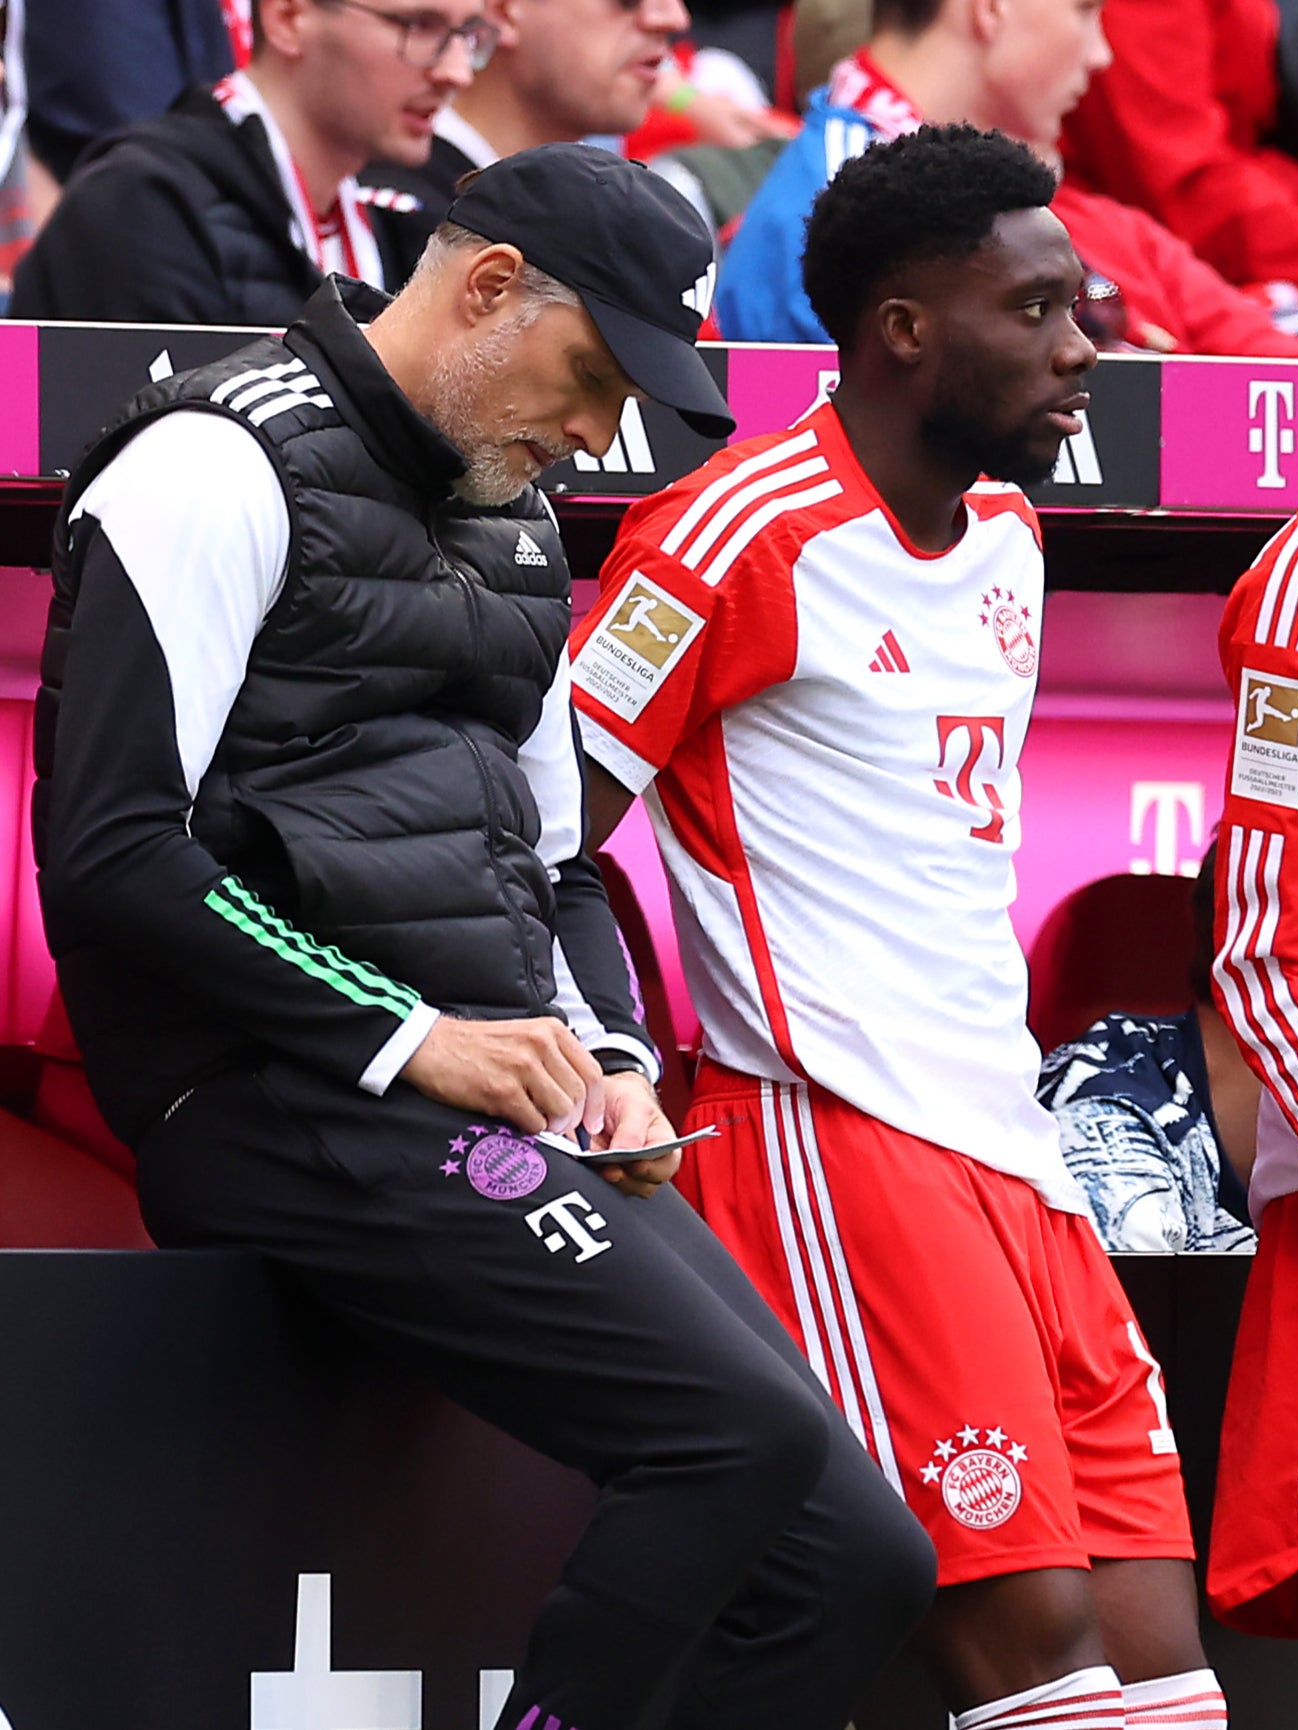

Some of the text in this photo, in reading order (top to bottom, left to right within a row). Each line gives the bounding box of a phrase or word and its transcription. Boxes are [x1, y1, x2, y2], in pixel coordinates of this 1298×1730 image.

[1249, 380, 1294, 488] T
[514, 553, 548, 567] adidas
[595, 635, 655, 683] BUNDESLIGA
[1241, 741, 1298, 763] BUNDESLIGA
[933, 715, 1005, 844] T
[524, 1190, 613, 1264] T
[949, 1456, 1010, 1490] FC BAYERN
